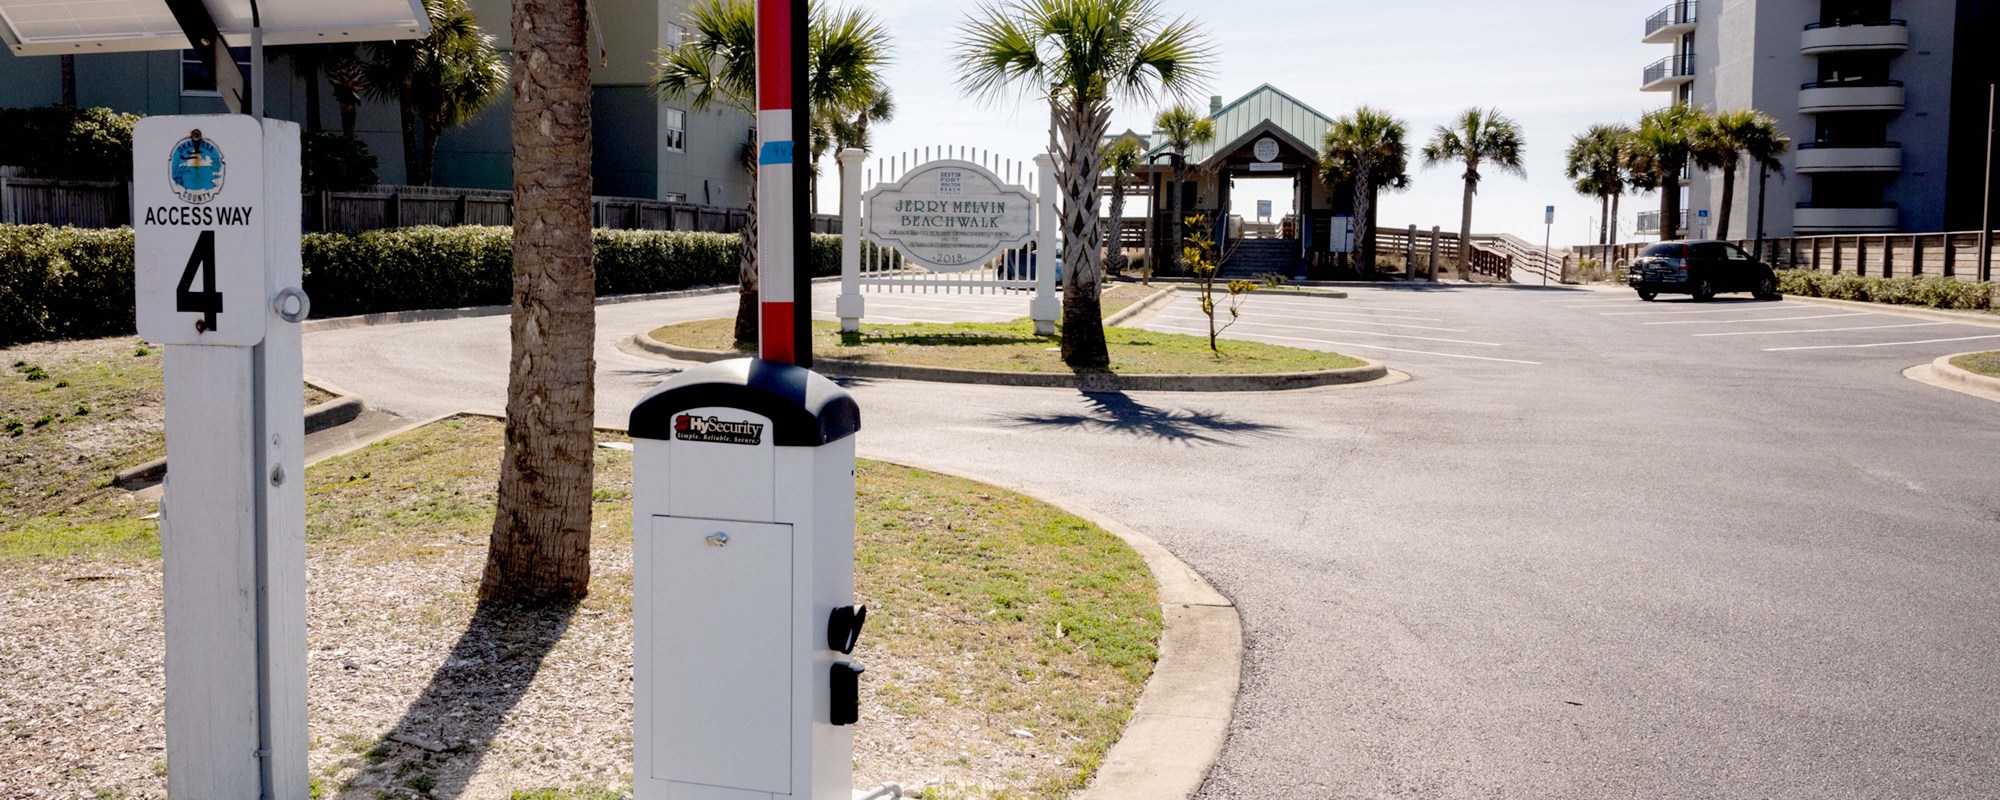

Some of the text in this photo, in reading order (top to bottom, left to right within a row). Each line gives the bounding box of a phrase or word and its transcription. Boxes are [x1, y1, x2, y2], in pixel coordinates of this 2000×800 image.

[177, 140, 214, 153] OKAOSA
[182, 191, 212, 202] COUNTY
[895, 200, 1005, 214] JERRY MELVIN
[145, 206, 252, 226] ACCESS WAY
[901, 215, 999, 228] BEACHWALK
[176, 230, 223, 331] 4
[690, 416, 760, 438] HySecurity
[677, 432, 701, 440] Simple.
[703, 434, 732, 442] Reliable.
